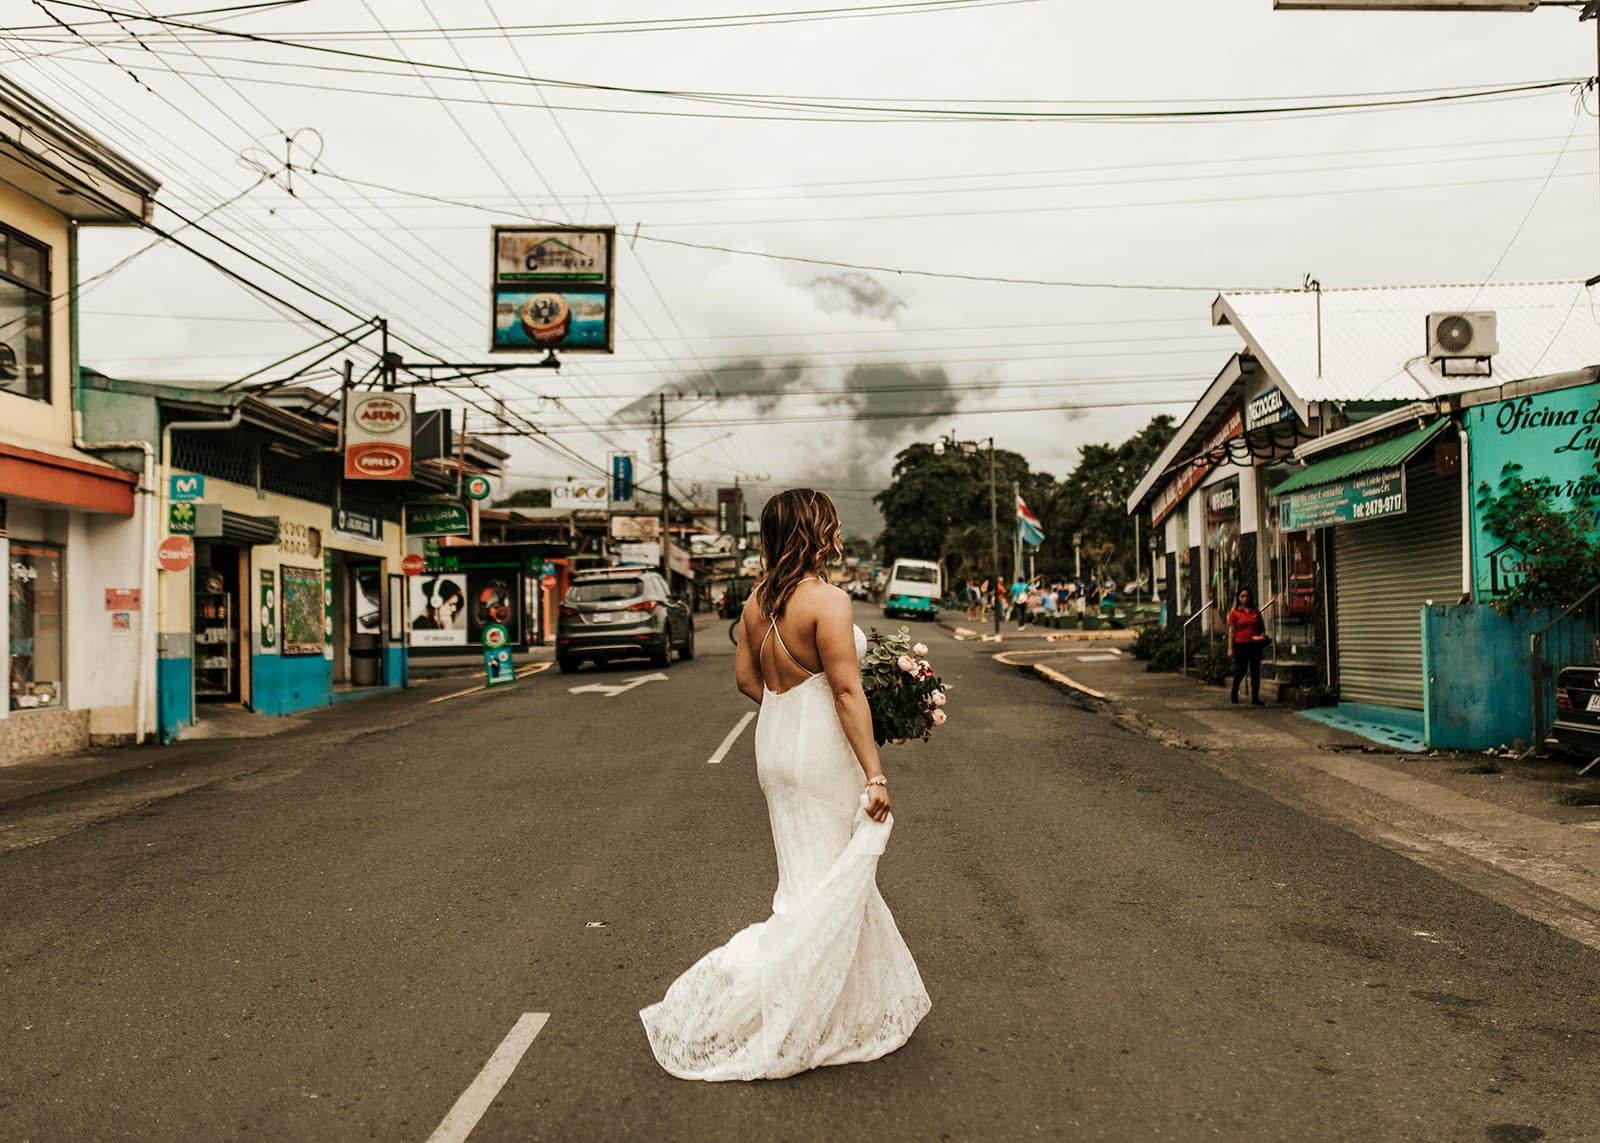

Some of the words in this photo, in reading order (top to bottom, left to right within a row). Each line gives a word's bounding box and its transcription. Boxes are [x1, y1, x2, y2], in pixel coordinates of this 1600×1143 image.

[361, 411, 400, 420] ASUN
[1496, 397, 1579, 434] Oficina
[1365, 494, 1402, 517] 2479-9717
